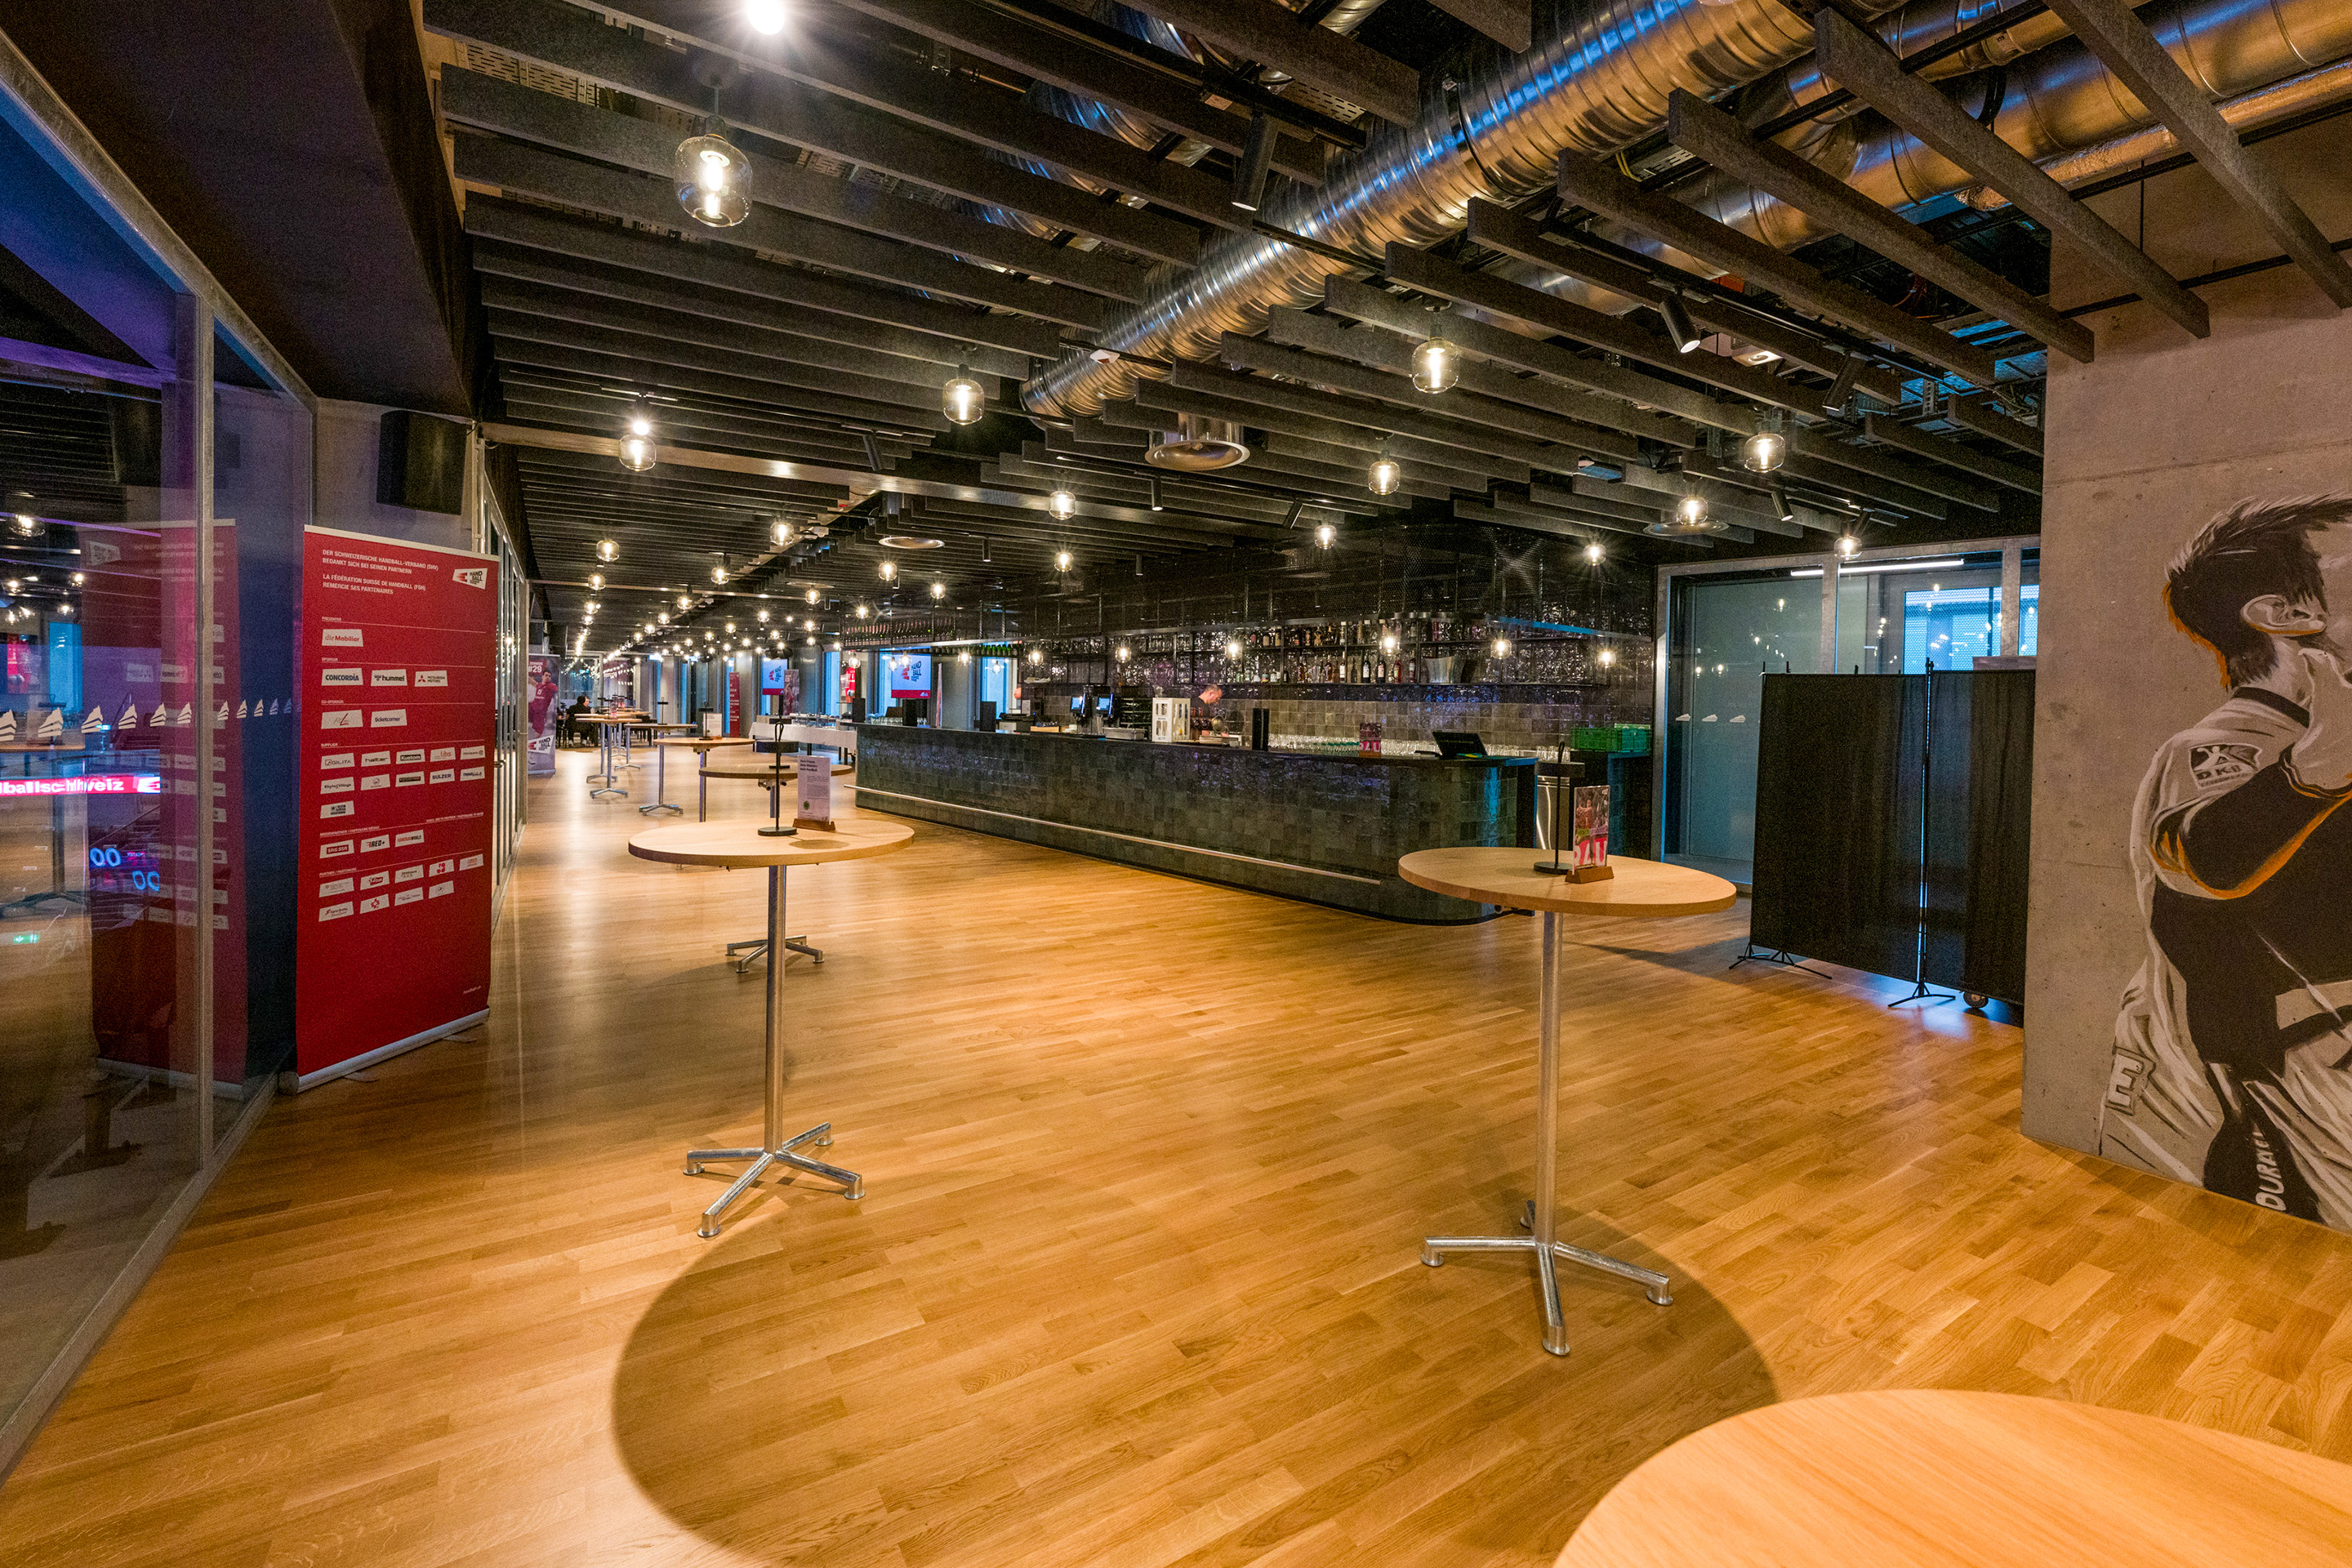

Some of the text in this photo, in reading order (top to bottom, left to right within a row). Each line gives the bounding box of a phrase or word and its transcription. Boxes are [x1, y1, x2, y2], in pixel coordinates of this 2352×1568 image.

[334, 551, 377, 562] SCHWEIZERISCHE
[378, 558, 426, 568] HANDBALL-VERBAND
[388, 566, 412, 574] PARTNERN
[331, 574, 362, 583] FÉDÉRATION
[389, 581, 413, 590] HANDBALL
[361, 586, 394, 595] PARTENAIRES
